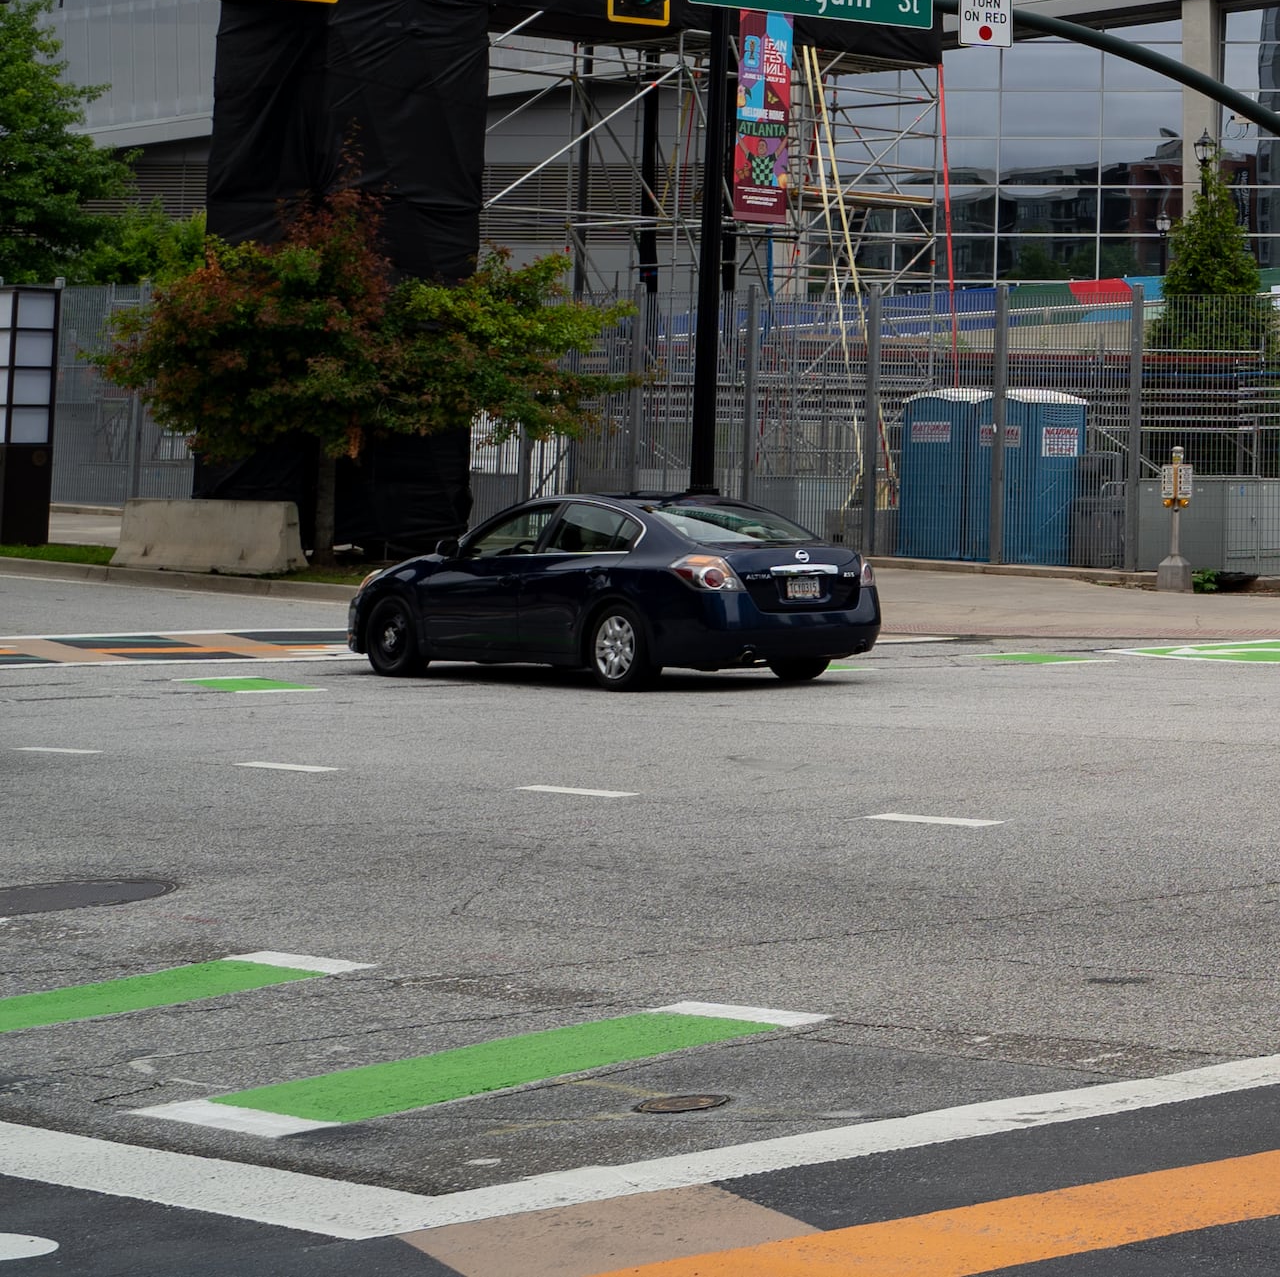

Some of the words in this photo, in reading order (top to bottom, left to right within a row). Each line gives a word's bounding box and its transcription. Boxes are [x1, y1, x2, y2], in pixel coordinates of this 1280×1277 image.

[964, 9, 980, 22] ON
[985, 11, 1007, 24] RED
[768, 39, 787, 53] FAN
[763, 50, 787, 64] FEST
[739, 121, 787, 136] ATLANTA
[1045, 428, 1078, 436] NATIONAL
